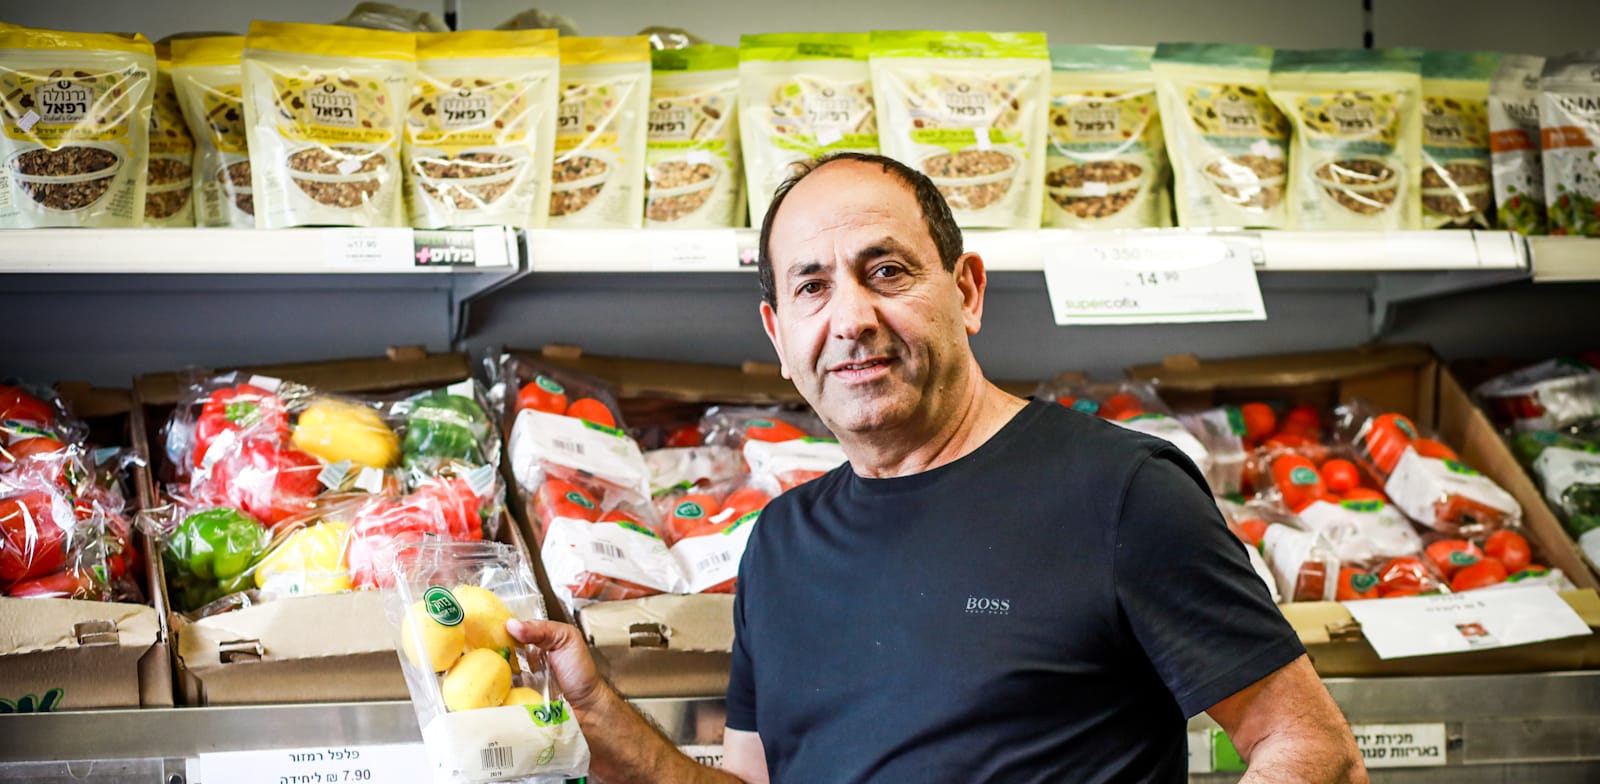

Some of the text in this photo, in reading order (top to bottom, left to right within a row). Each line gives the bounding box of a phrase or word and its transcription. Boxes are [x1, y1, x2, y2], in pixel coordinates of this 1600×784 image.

[43, 88, 87, 102] גרנולה
[43, 101, 87, 114] רפאל
[312, 103, 353, 118] רפאל
[444, 108, 487, 120] רפאל
[1137, 272, 1158, 286] 14
[966, 597, 1010, 611] BOSS
[1375, 733, 1413, 744] מכירת
[288, 748, 360, 762] פלפל רמזור
[1391, 746, 1439, 758] באריזות
[280, 772, 321, 784] ליחידה
[343, 769, 371, 781] 7.90
